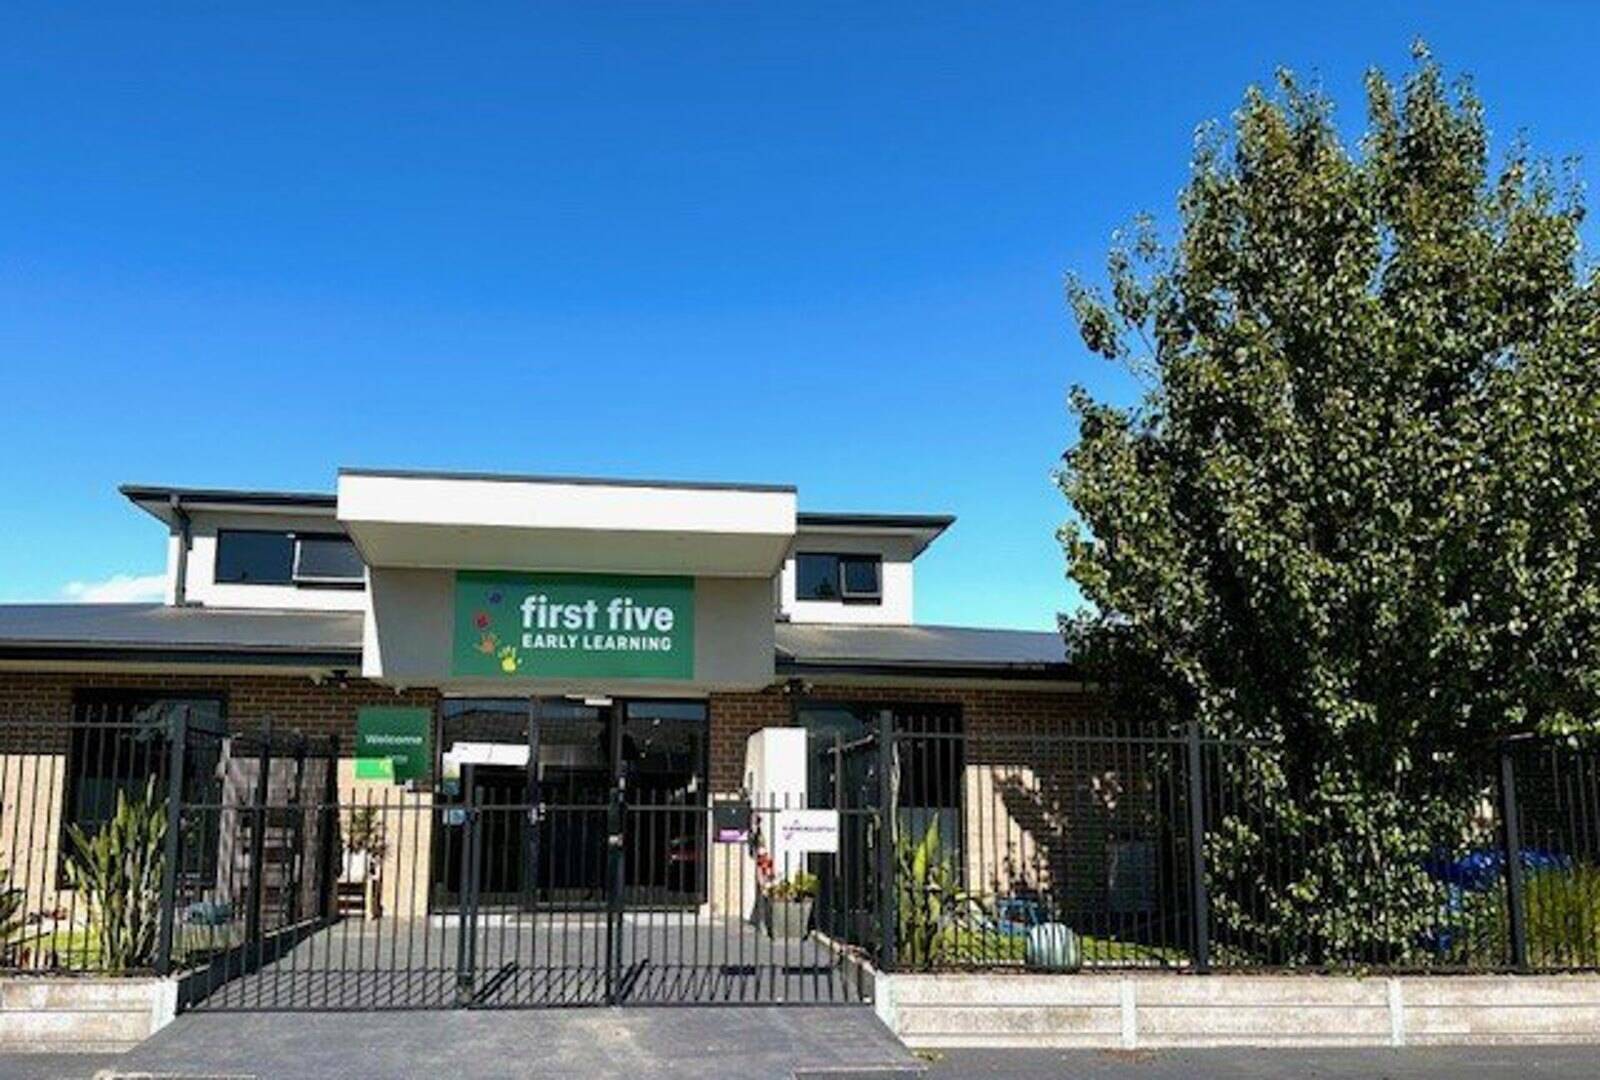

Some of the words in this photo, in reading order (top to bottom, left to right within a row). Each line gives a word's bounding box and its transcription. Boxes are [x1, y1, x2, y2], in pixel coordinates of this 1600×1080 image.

[520, 595, 598, 630] first
[607, 597, 674, 632] five
[522, 634, 578, 648] EARLY
[582, 635, 672, 650] LEARNING
[364, 734, 423, 745] Welcome
